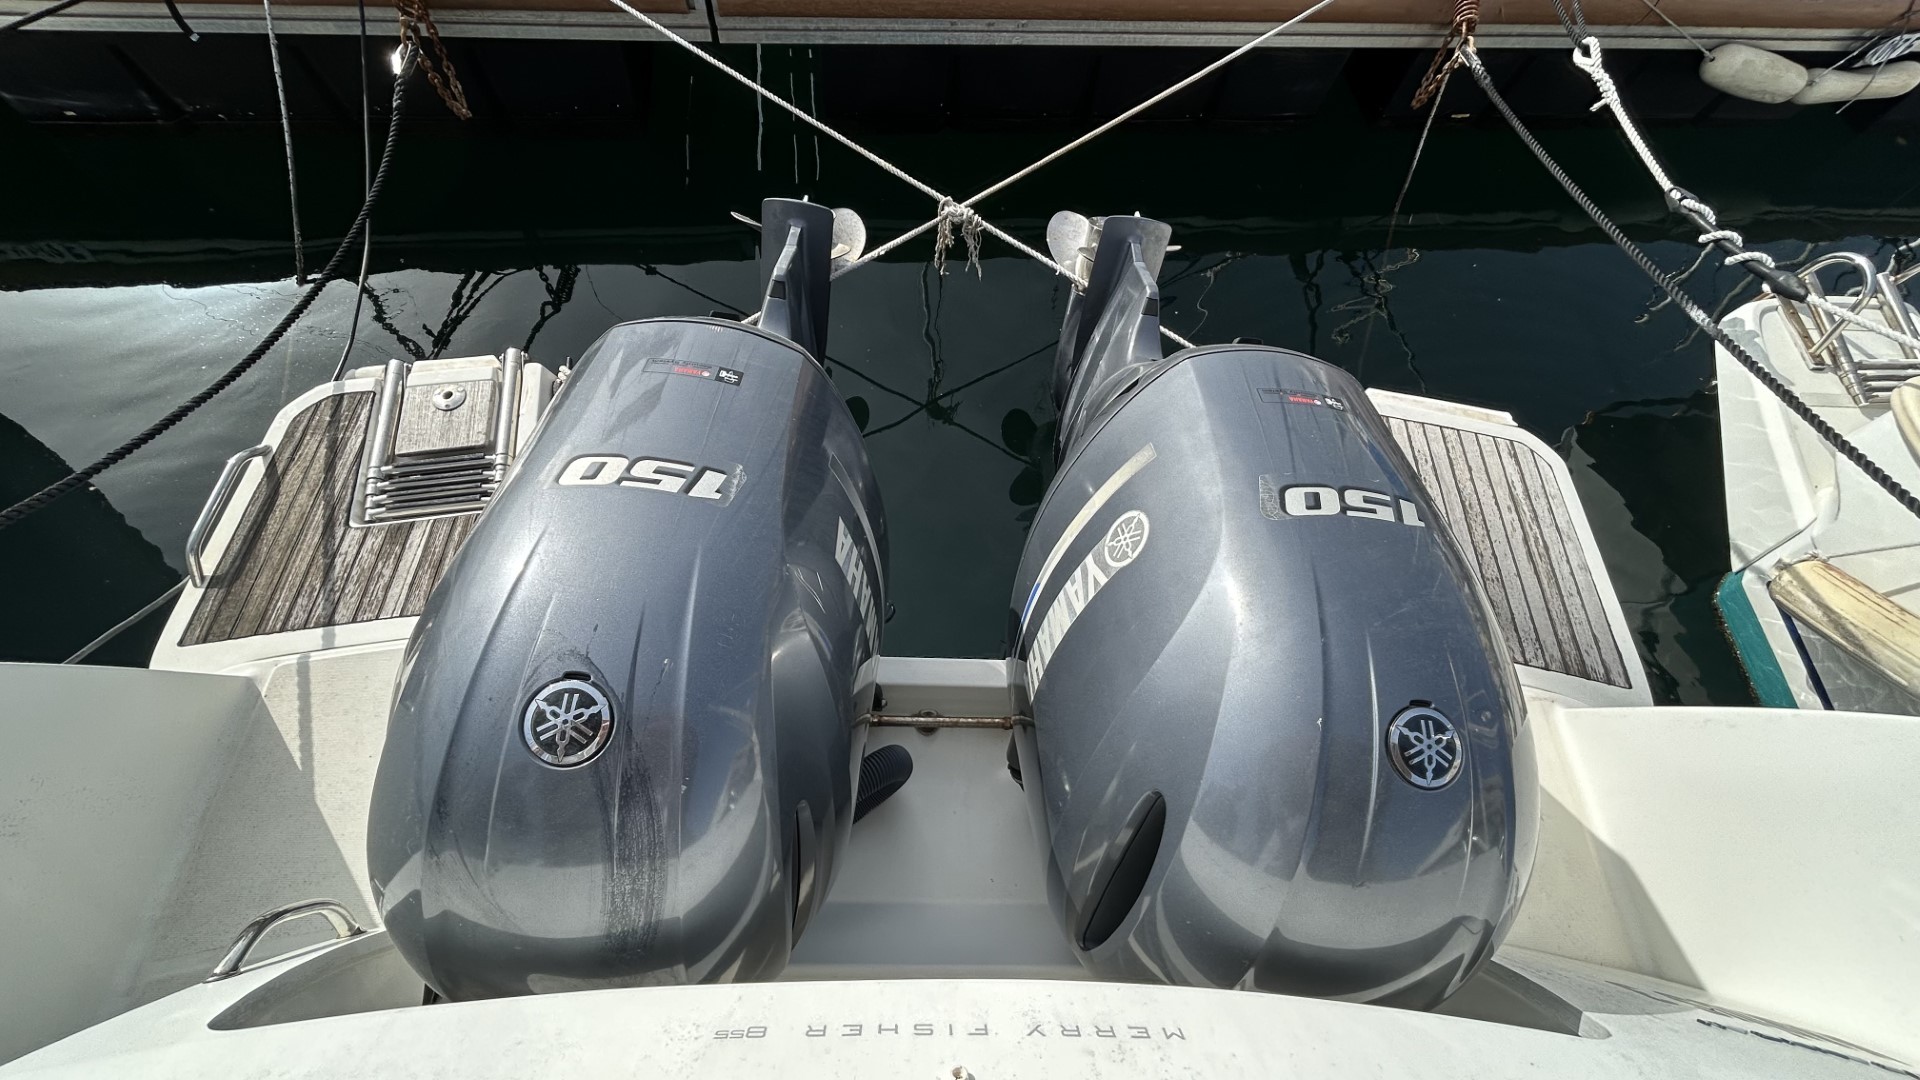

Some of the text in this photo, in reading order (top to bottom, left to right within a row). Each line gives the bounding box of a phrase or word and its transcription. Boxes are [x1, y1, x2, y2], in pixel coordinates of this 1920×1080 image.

[559, 456, 728, 500] 150
[1284, 486, 1426, 527] 150
[713, 1023, 1186, 1040] MERRY FISHER 855
